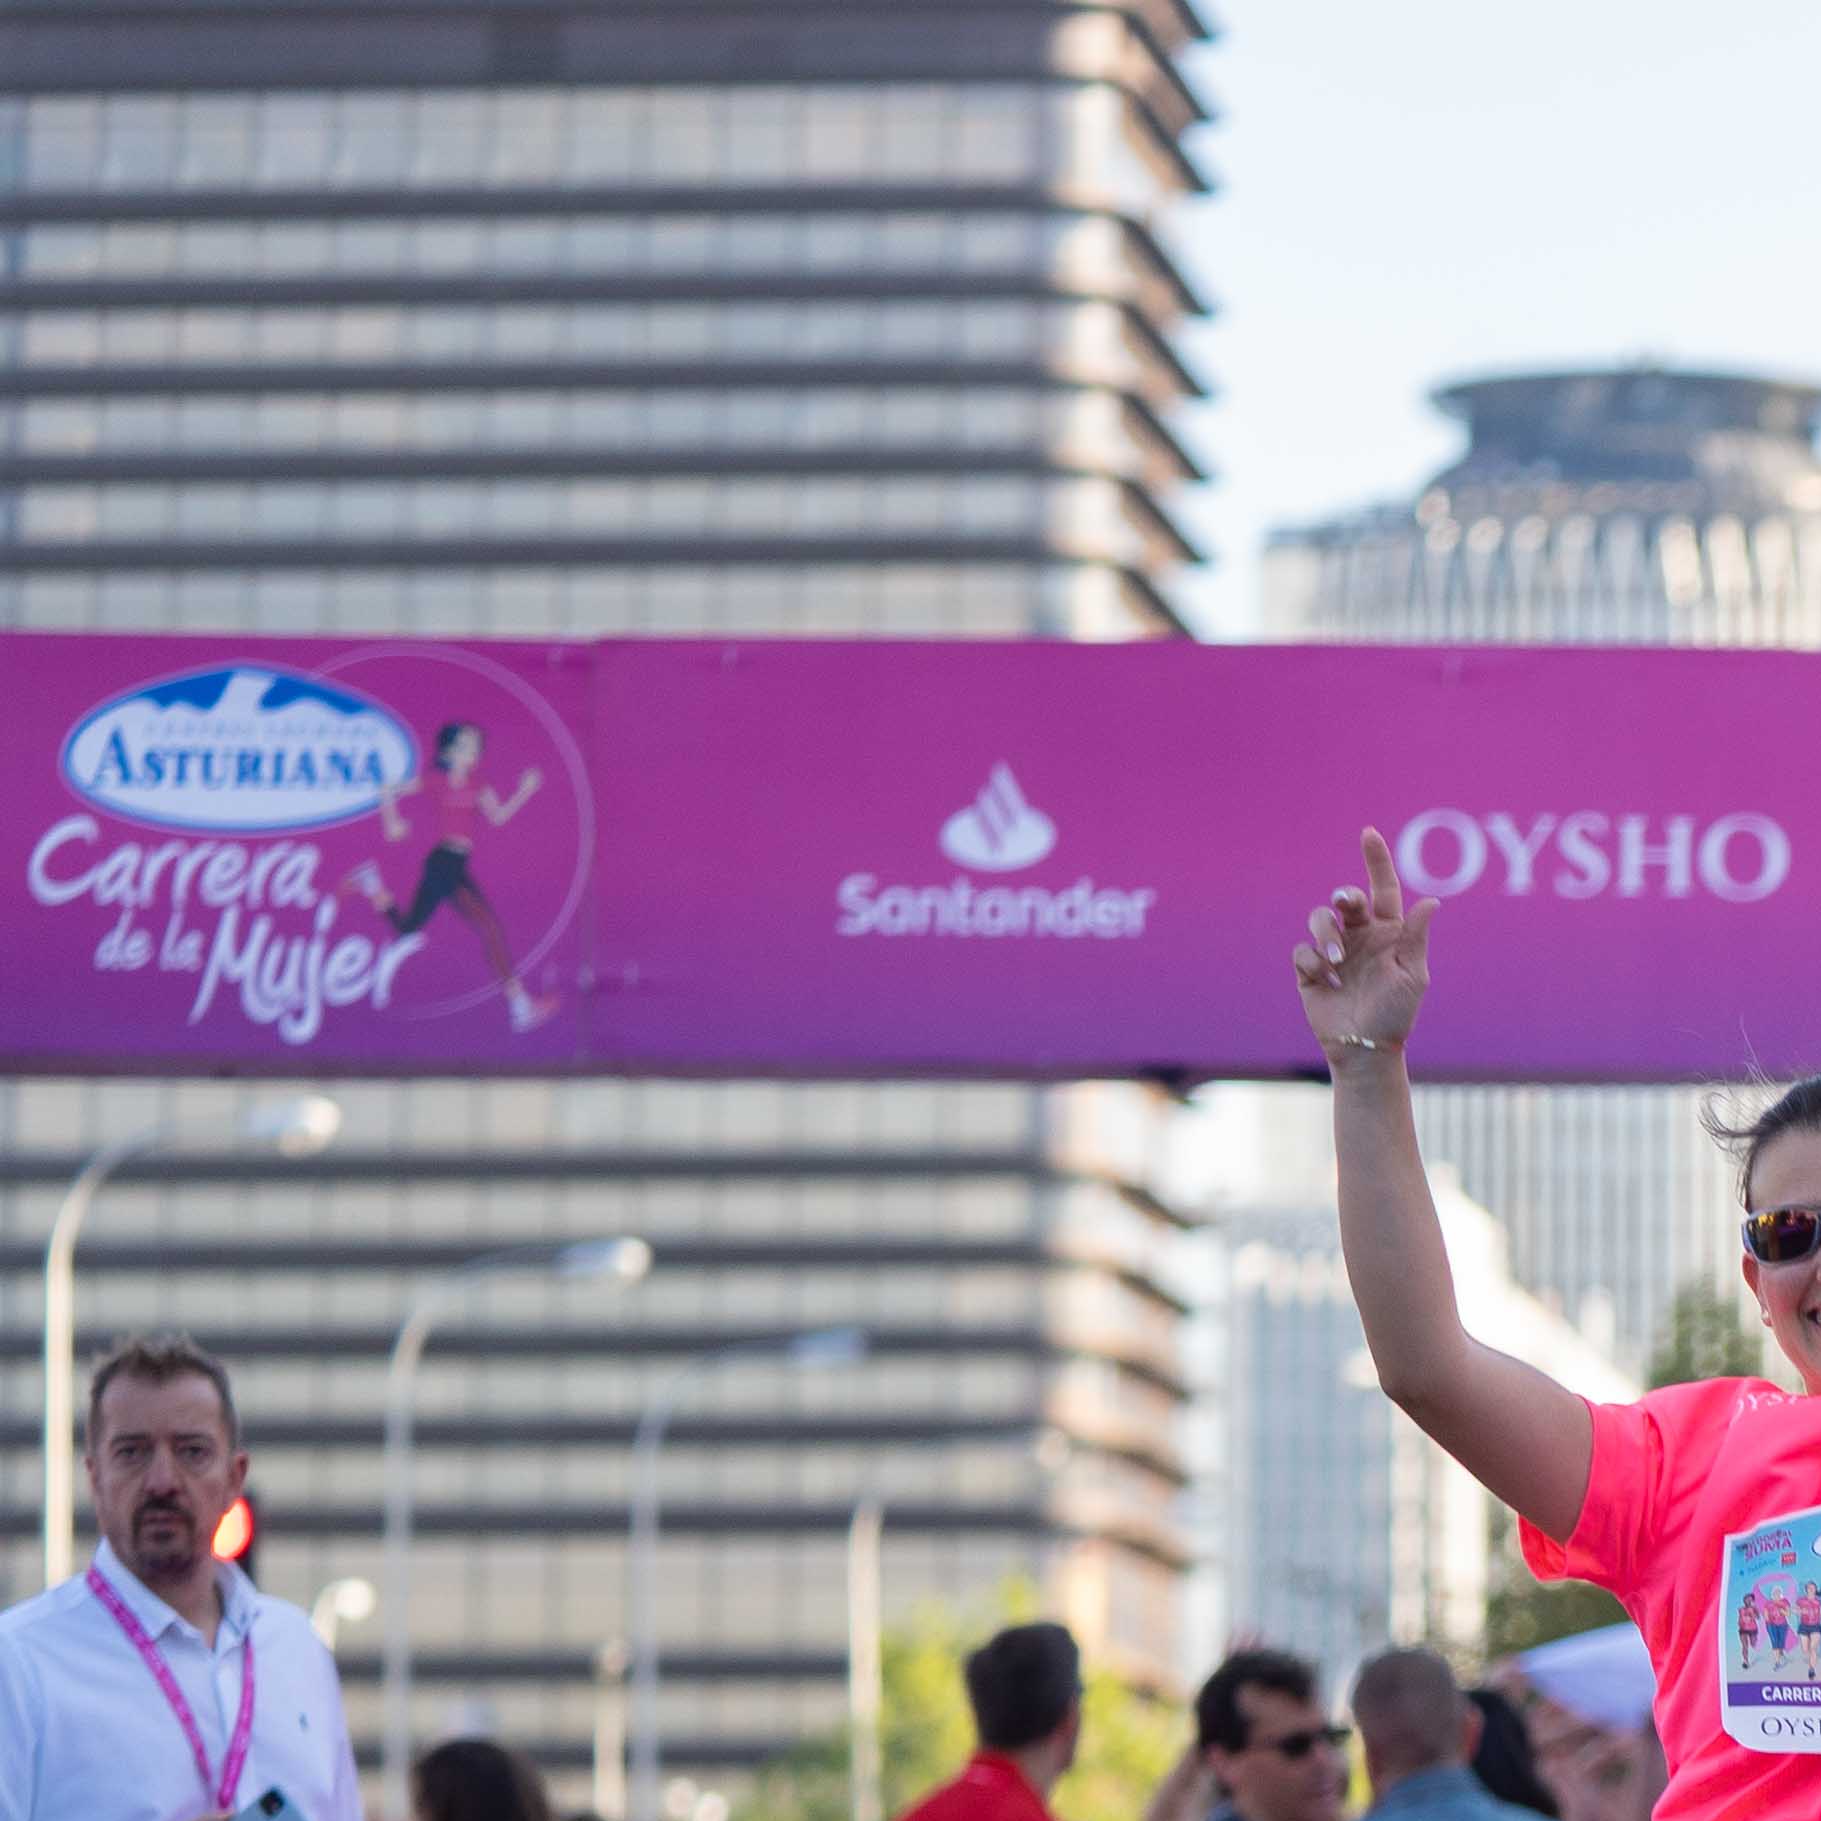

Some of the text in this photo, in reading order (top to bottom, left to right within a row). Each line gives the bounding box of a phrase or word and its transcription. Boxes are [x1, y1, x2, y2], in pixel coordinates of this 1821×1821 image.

[90, 726, 385, 791] ASTURIANA
[27, 814, 321, 908] Carrera
[1399, 806, 1792, 904] OYSHO
[835, 871, 1156, 939] Santander
[94, 895, 427, 1044] de la Mujer
